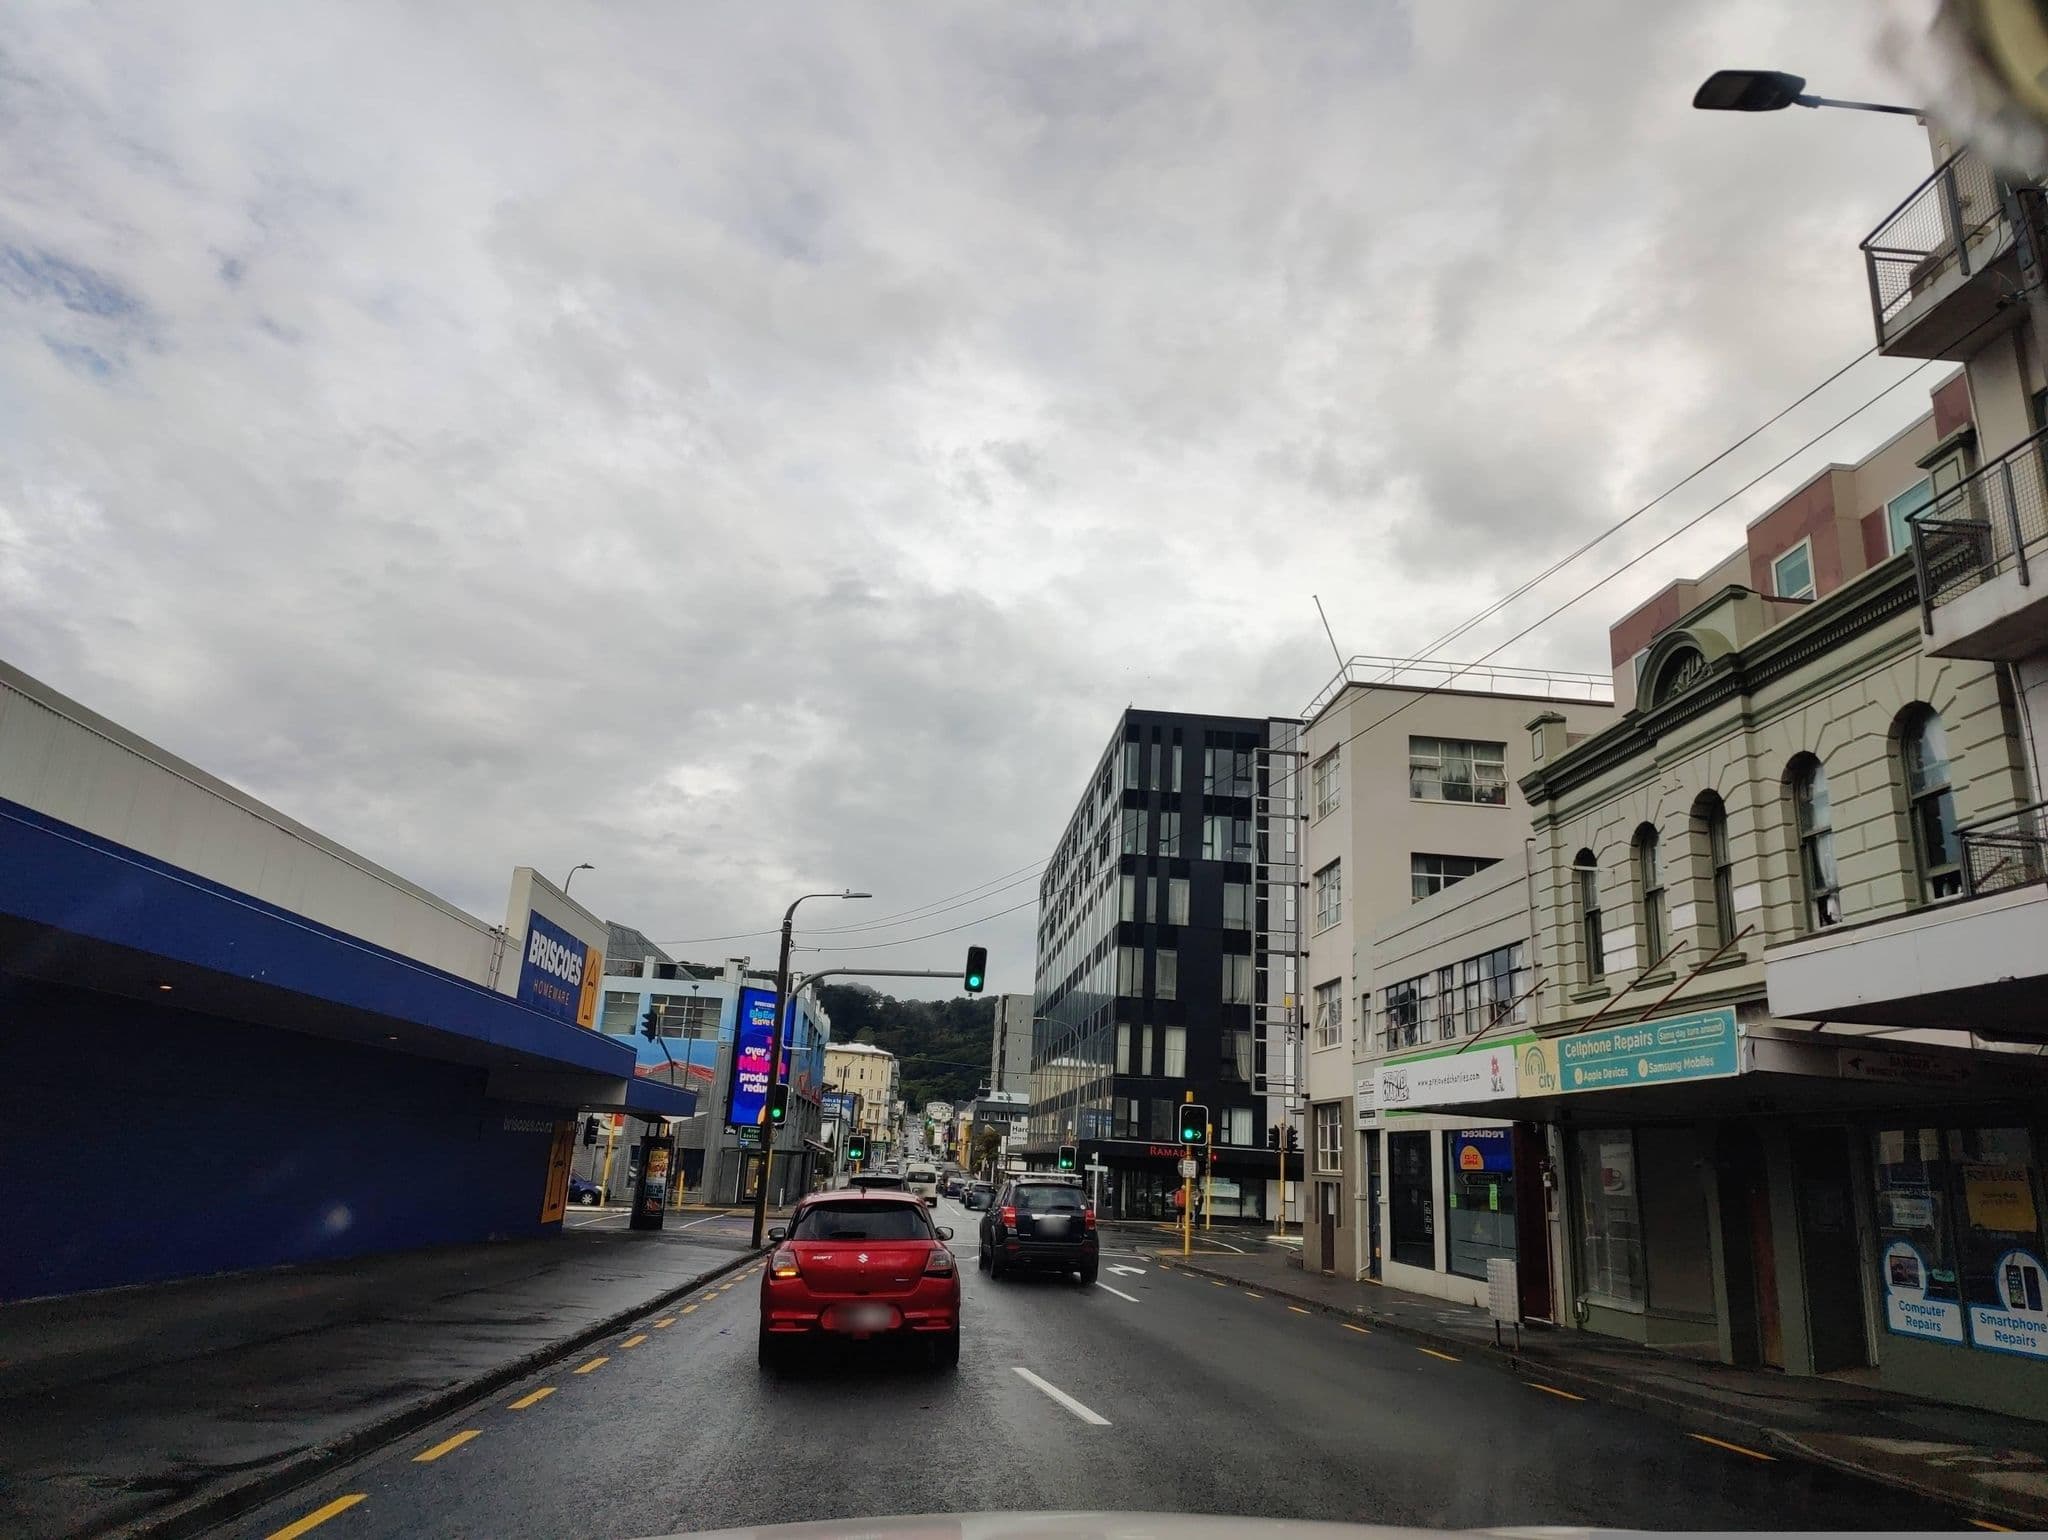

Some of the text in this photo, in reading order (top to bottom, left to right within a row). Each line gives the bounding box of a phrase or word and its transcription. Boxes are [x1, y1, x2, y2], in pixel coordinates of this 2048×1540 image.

[529, 930, 582, 986] BRISCOES
[534, 979, 570, 1006] HOMEWARE
[752, 1017, 770, 1027] Save
[1675, 1029, 1686, 1039] day
[745, 1046, 766, 1056] over
[1565, 1031, 1653, 1059] Cellphone Repairs
[1649, 1055, 1714, 1074] Samsung Mobiles
[740, 1072, 768, 1083] produ
[1539, 1072, 1556, 1090] city
[1583, 1066, 1629, 1082] Apple Devices
[1150, 1146, 1188, 1158] RAMAD
[1898, 1300, 1946, 1319] Computer
[1905, 1315, 1942, 1332] Repairs
[1980, 1312, 2048, 1333] Smartphone
[1995, 1330, 2037, 1348] Repairs
